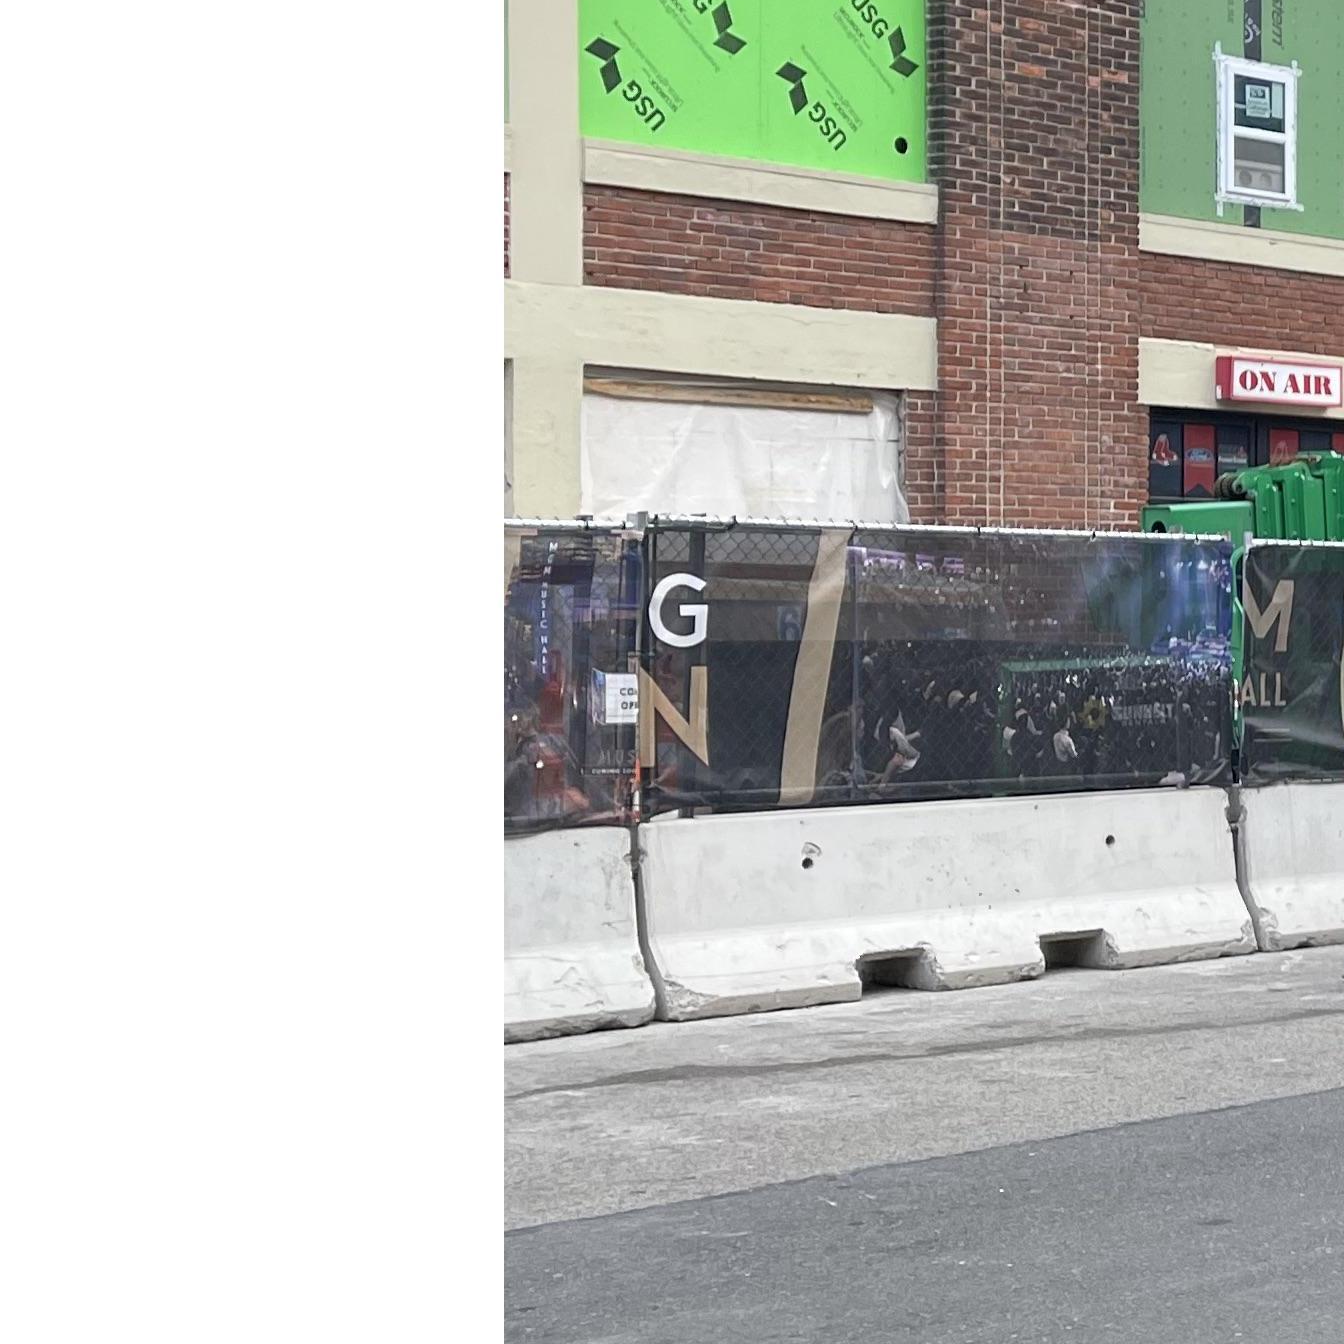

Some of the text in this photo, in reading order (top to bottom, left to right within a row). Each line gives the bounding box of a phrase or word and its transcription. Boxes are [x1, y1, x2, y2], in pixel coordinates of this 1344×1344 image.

[622, 80, 666, 132] USG
[808, 101, 847, 151] USG
[1238, 368, 1332, 395] ON AIR
